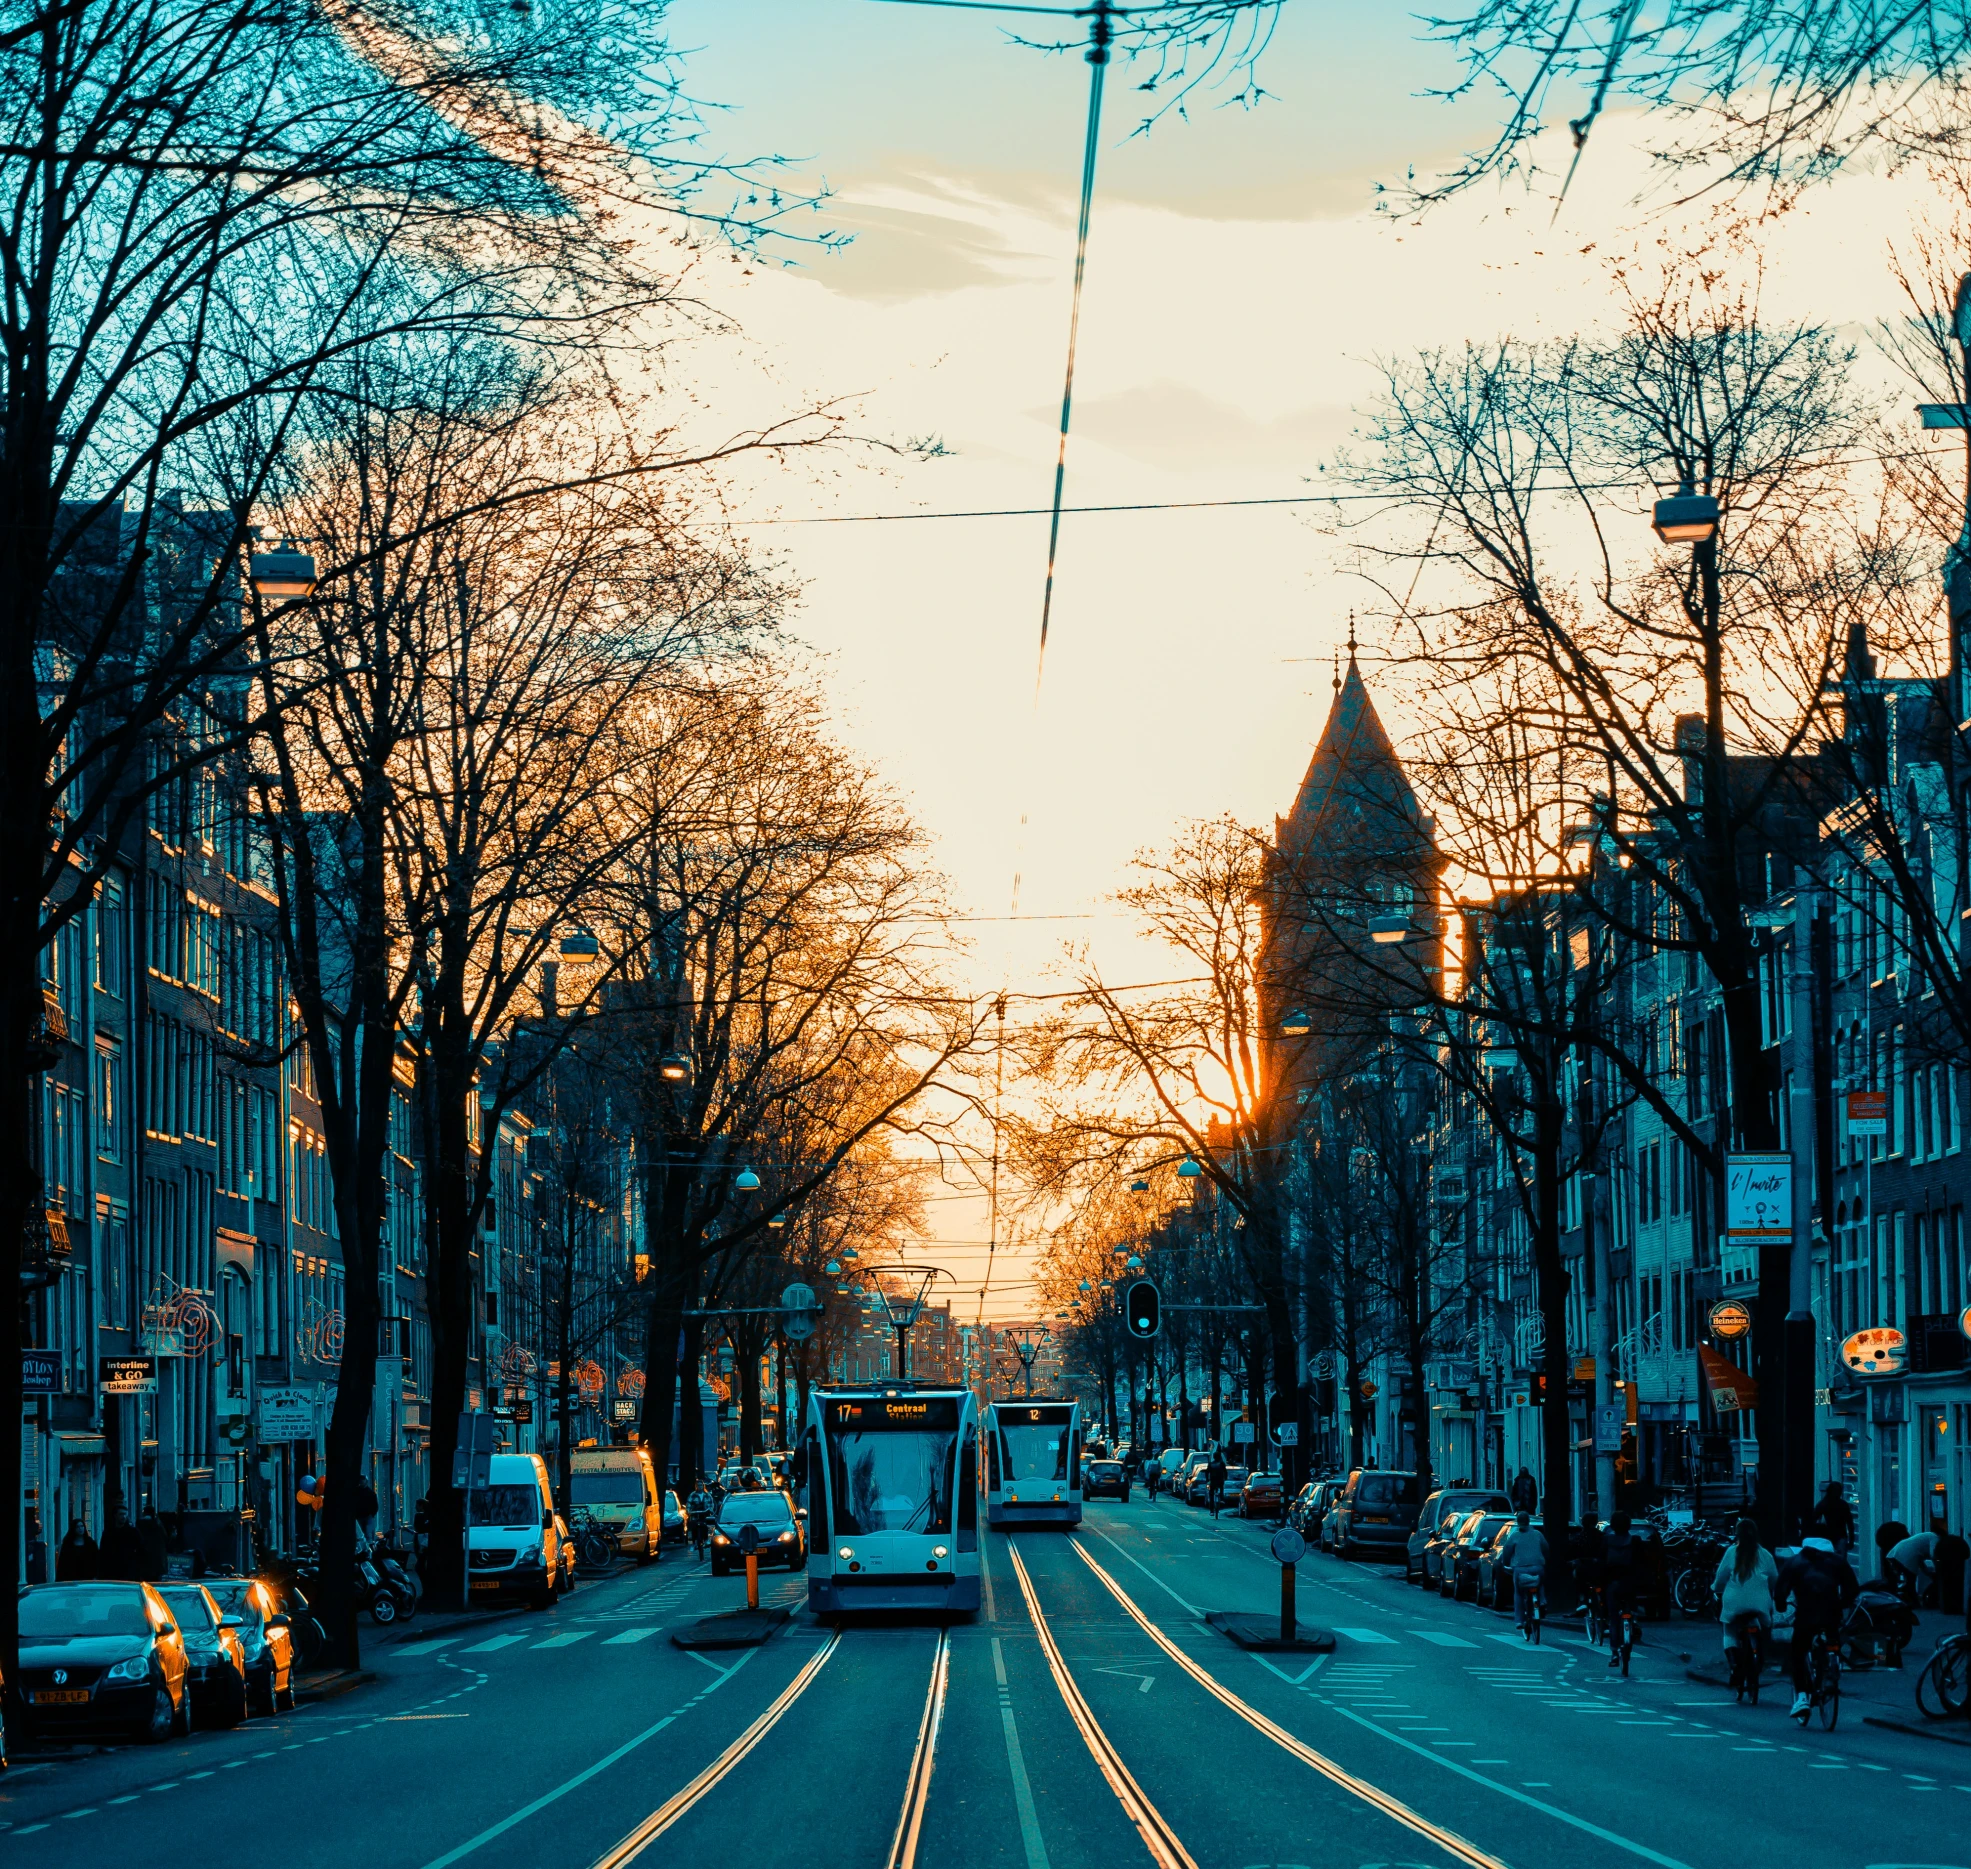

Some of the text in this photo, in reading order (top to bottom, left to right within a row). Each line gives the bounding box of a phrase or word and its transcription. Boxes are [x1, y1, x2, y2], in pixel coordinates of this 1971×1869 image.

[1713, 1317, 1747, 1325] Heineken
[107, 1361, 150, 1370] interline
[114, 1370, 144, 1381] & GO
[108, 1381, 150, 1391] takeaway
[837, 1403, 927, 1422] 17 Centraal
[1029, 1408, 1039, 1421] 12
[1236, 1425, 1252, 1435] 30
